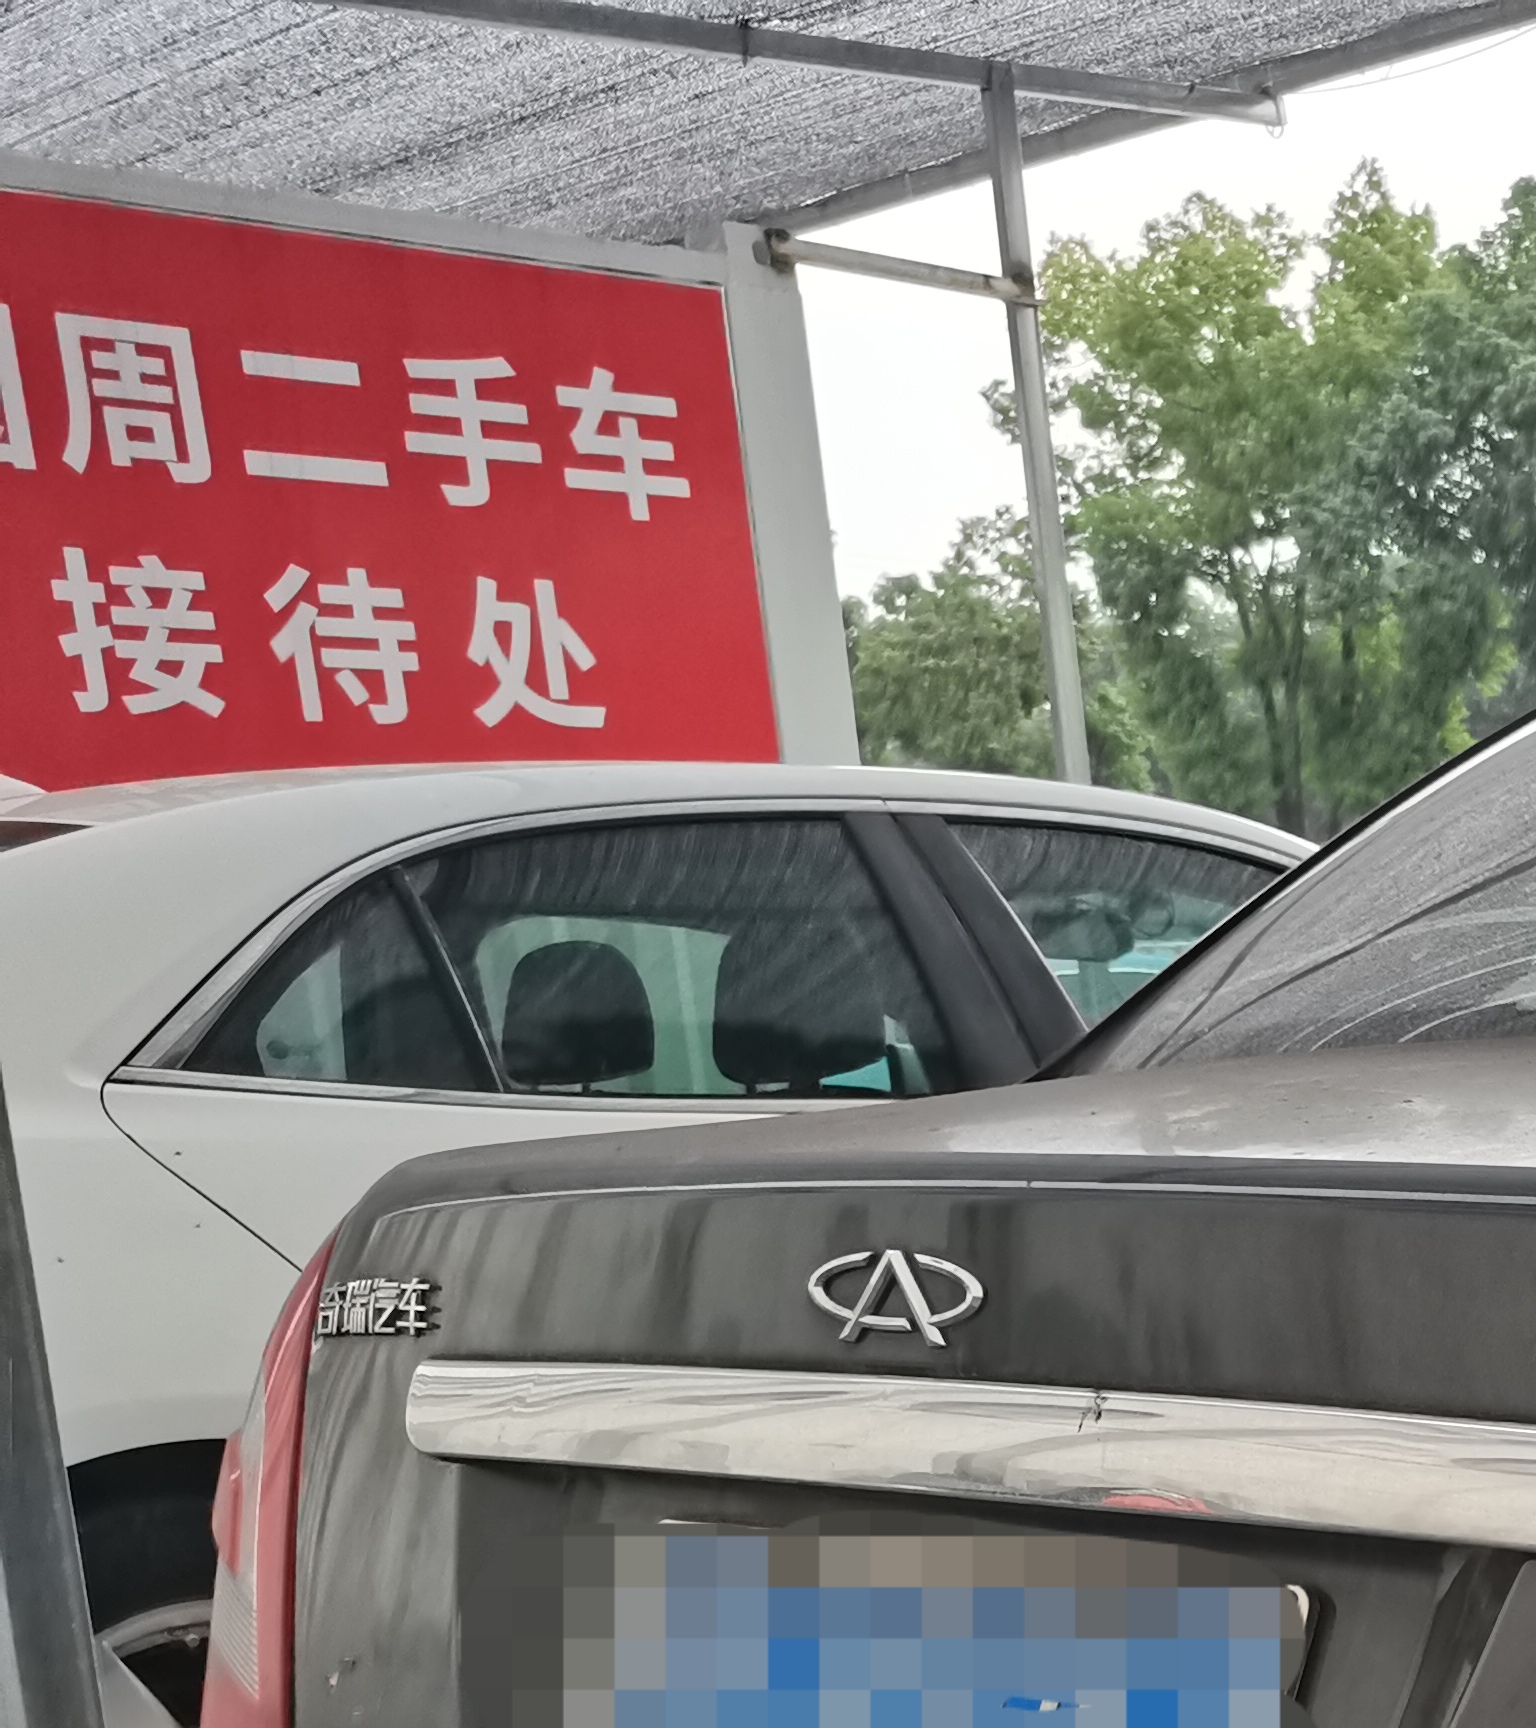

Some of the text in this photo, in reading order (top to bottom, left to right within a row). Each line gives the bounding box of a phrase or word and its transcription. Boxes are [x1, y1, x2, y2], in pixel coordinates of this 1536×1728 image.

[0, 303, 691, 522] 周二手车
[51, 546, 607, 729] 接待处
[316, 1277, 431, 1336] 奇瑞汽车
